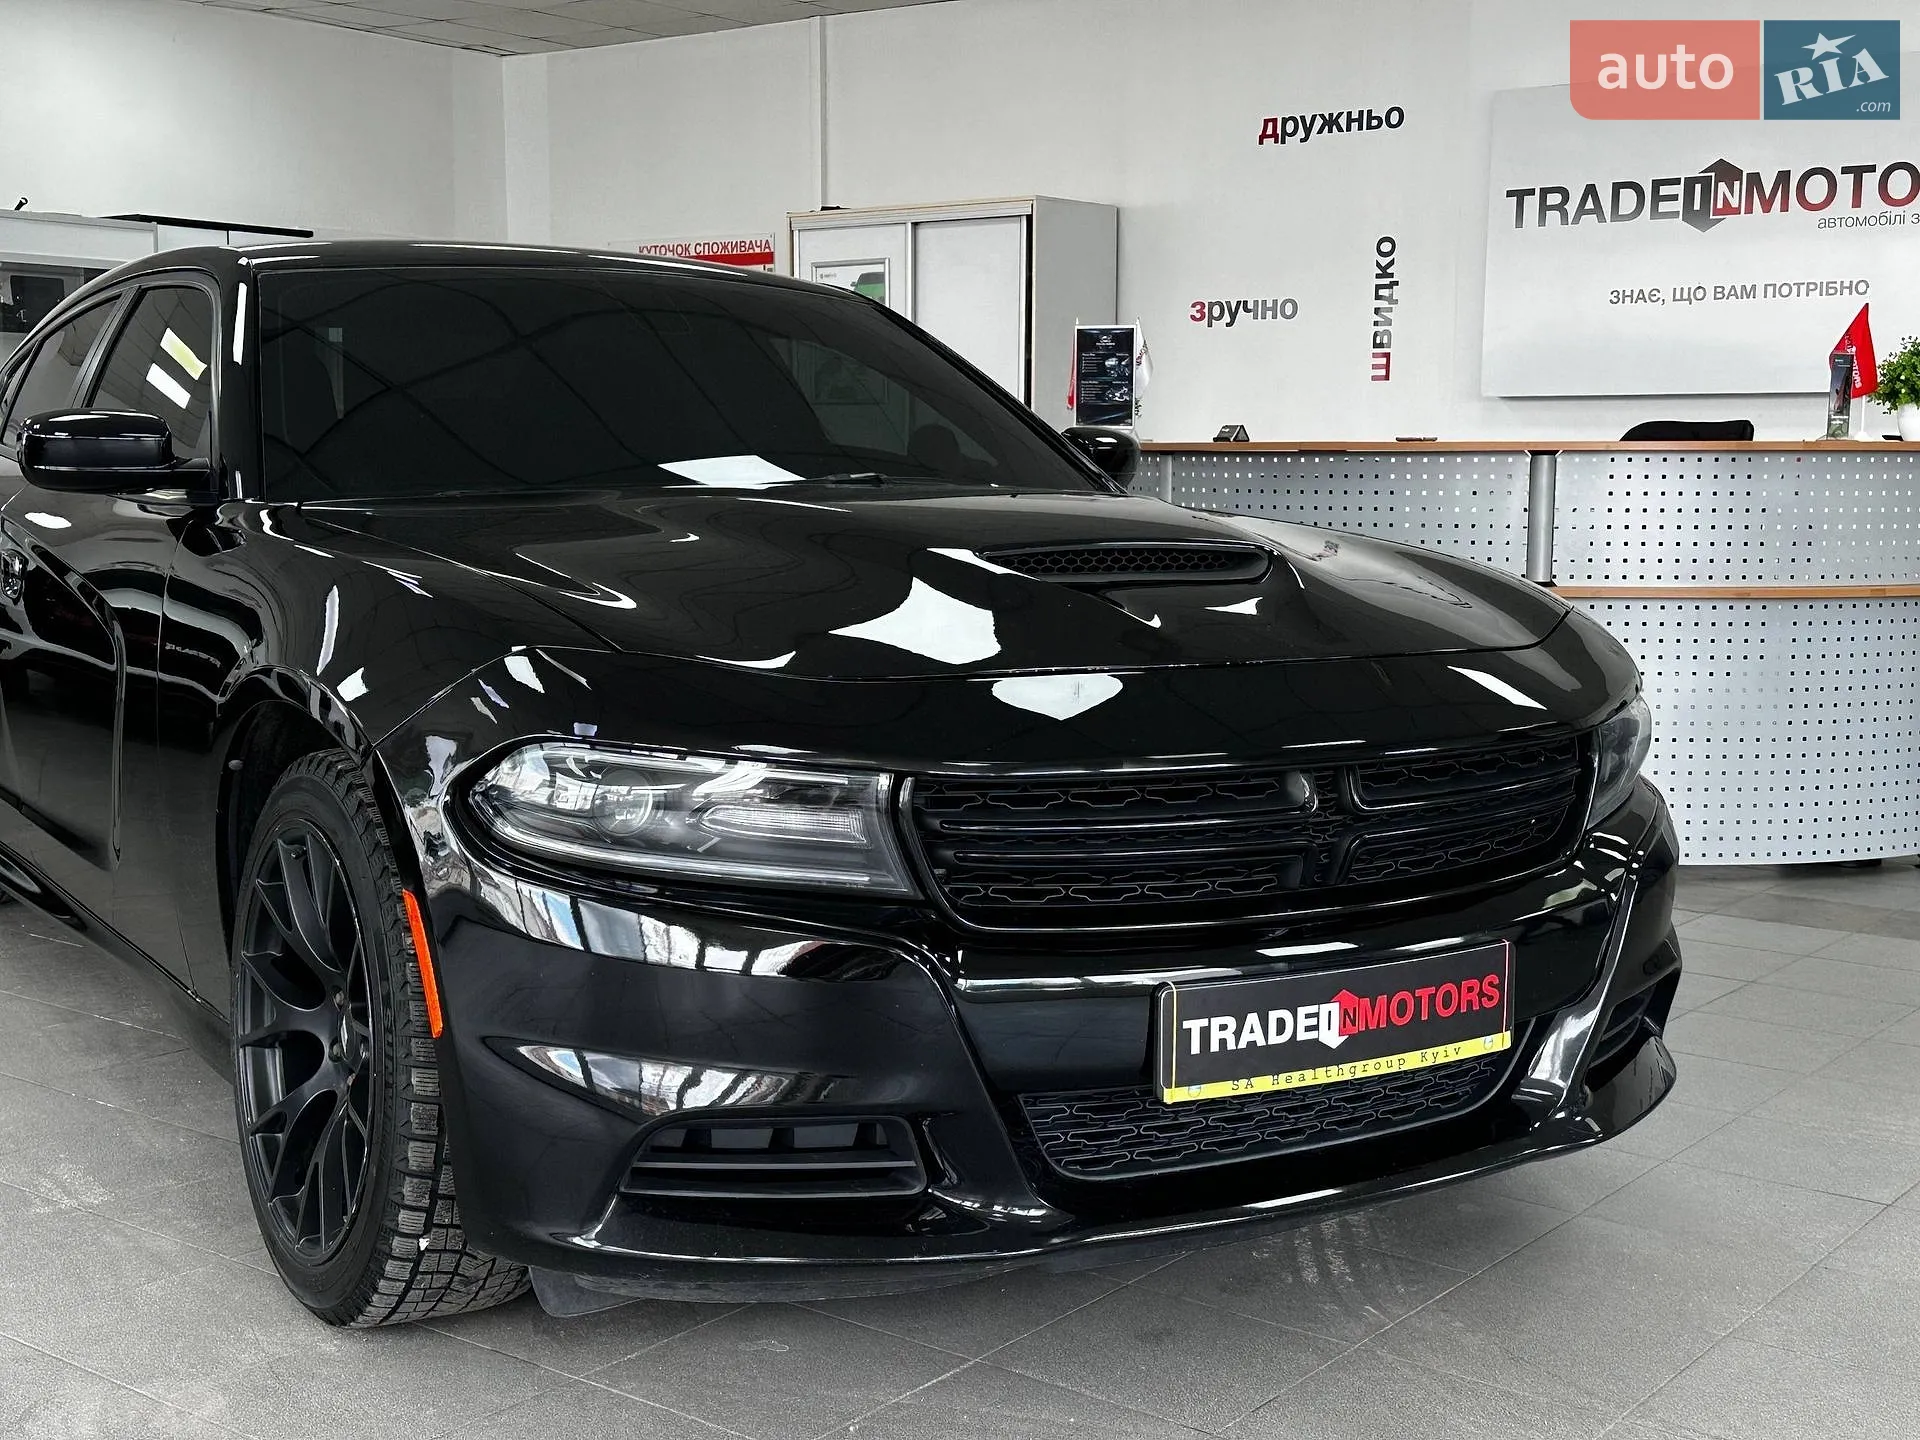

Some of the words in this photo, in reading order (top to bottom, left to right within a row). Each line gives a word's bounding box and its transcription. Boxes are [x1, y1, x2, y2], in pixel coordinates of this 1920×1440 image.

[1258, 105, 1405, 145] дружньо
[1817, 210, 1906, 230] автомобілі
[694, 239, 772, 256] СПОЖИВАЧА
[1672, 285, 1707, 306] ЩО
[1713, 284, 1757, 301] ВАМ
[1763, 279, 1870, 300] ПОТРІБНО
[1189, 297, 1299, 328] зручно
[1271, 1056, 1407, 1086] Healthgroup
[1420, 1045, 1463, 1063] Kyiv
